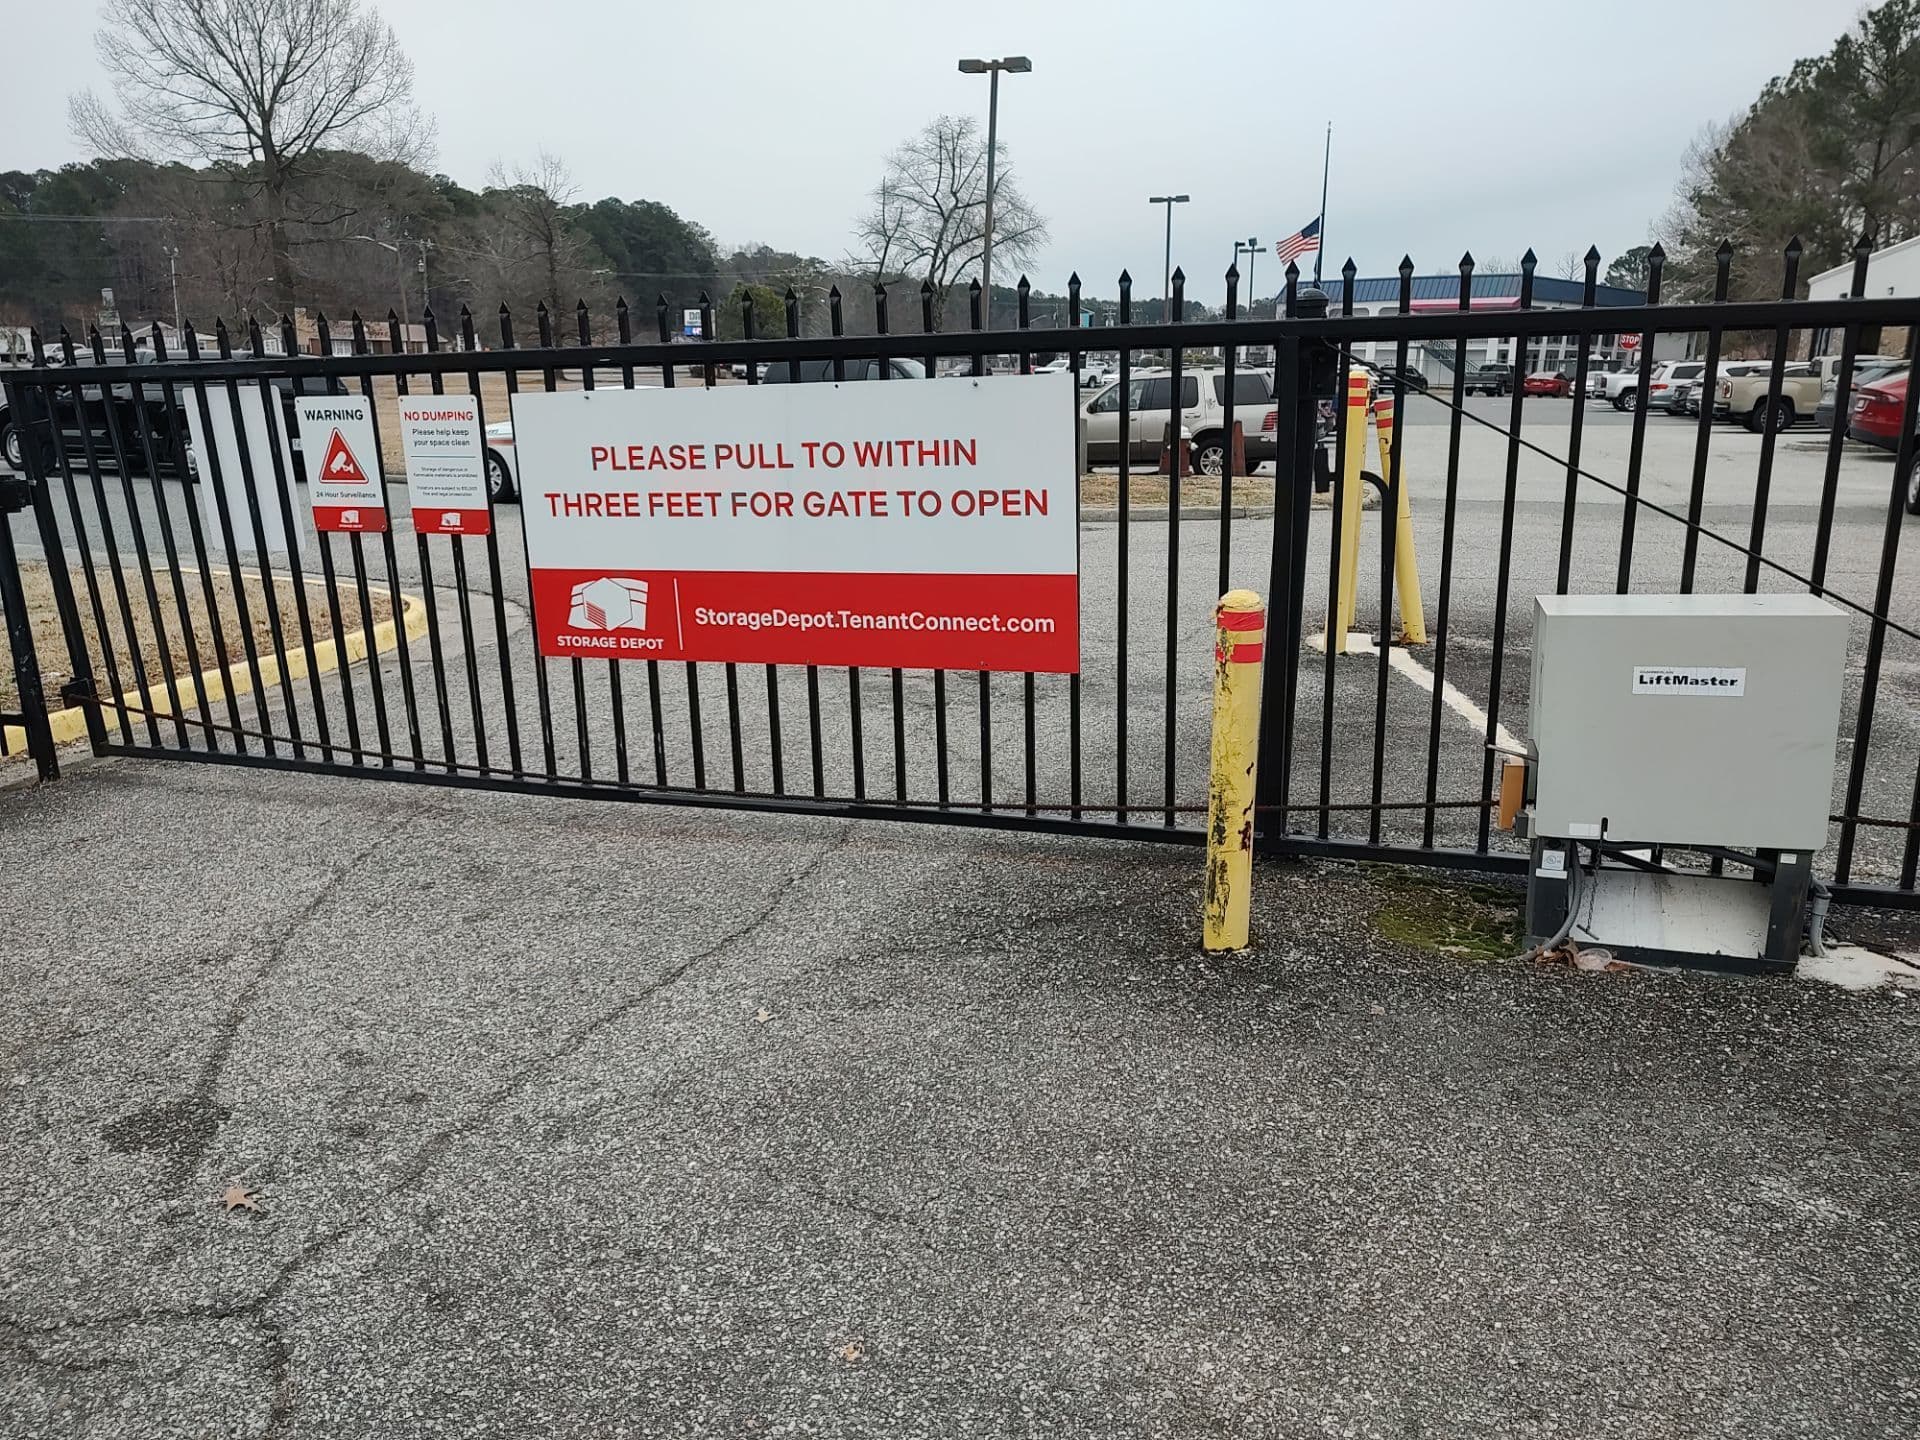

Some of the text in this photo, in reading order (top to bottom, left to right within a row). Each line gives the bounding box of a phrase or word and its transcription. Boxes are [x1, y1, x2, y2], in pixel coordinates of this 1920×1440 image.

[1621, 335, 1640, 345] STOP
[304, 409, 363, 421] WARNING
[404, 411, 474, 421] NO DUMPING
[412, 428, 469, 437] Please help keep
[430, 440, 450, 448] space
[591, 439, 977, 471] PLEASE PULL TO WITHIN
[544, 489, 1048, 518] THREE FEET FOR GATE TO OPEN
[695, 607, 1055, 633] StorageDepot.TenantConnect.com
[557, 635, 664, 650] STORAGE DEPOT
[1639, 674, 1738, 687] LiftMaster
